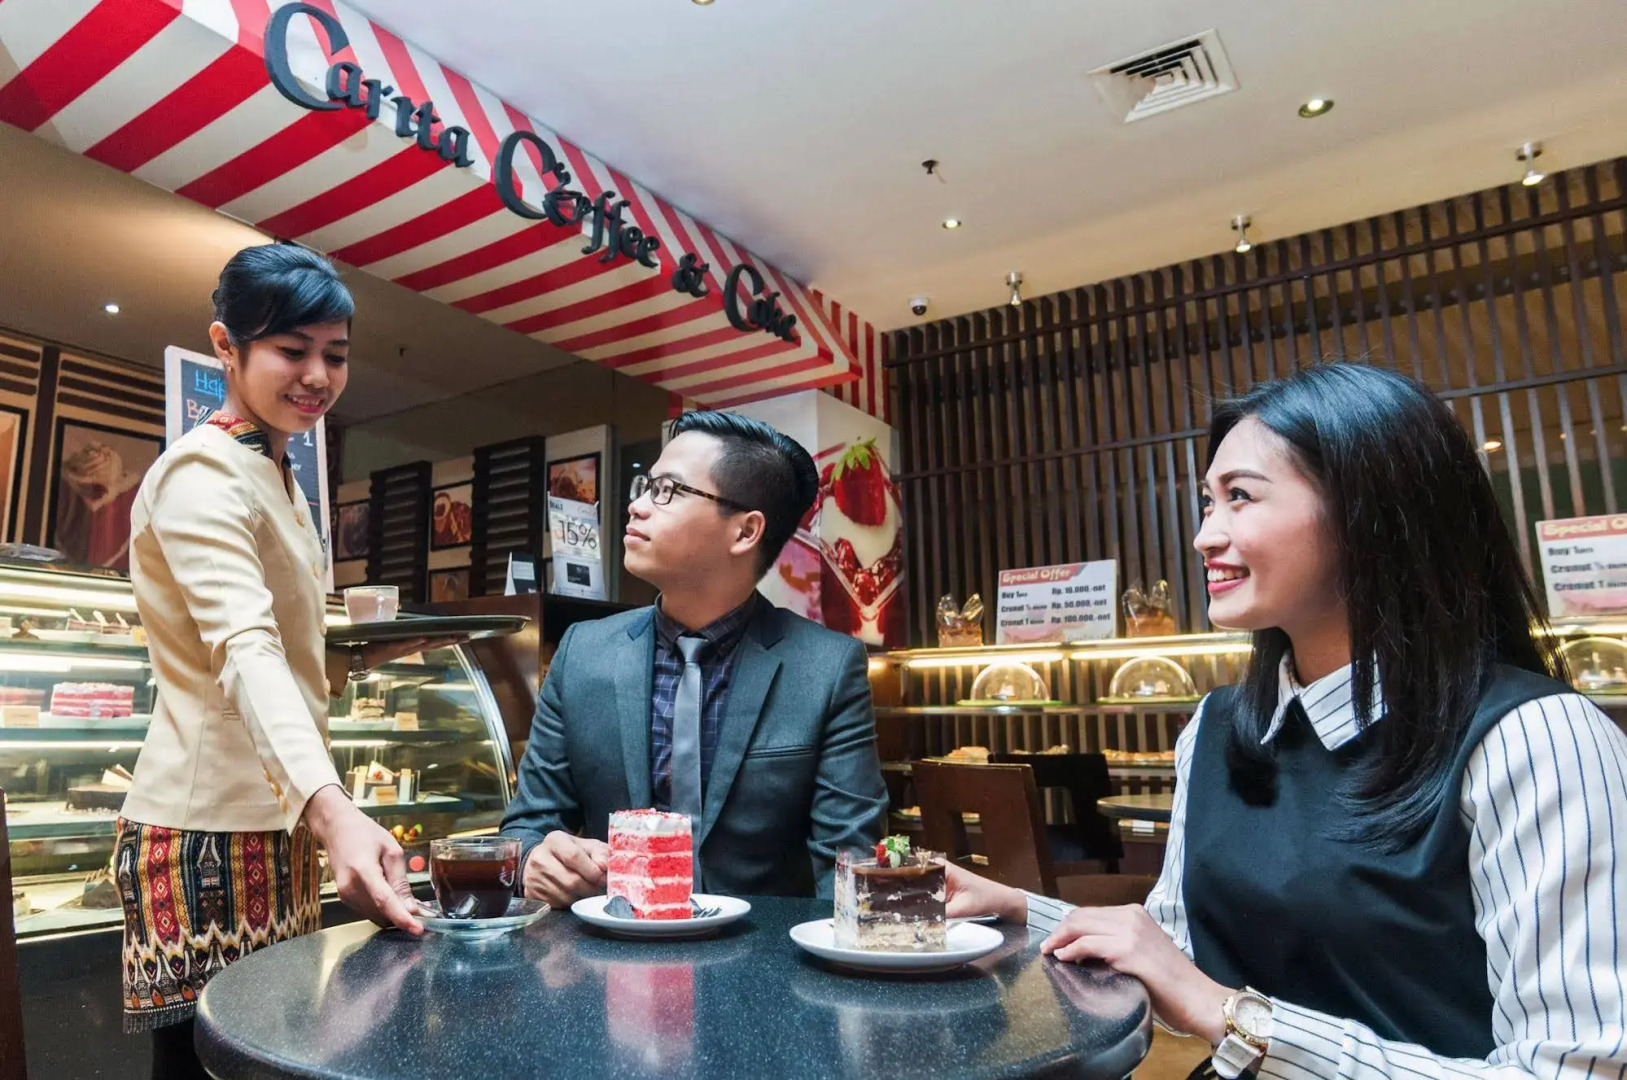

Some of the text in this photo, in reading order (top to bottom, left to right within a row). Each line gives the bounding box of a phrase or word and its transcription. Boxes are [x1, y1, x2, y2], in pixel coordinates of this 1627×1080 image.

[494, 130, 660, 268] Coffee
[671, 253, 710, 298] &
[724, 264, 797, 342] Cake
[559, 520, 597, 549] 15%
[1544, 519, 1607, 538] Special
[1548, 547, 1569, 556] Buy
[1002, 567, 1071, 585] Special Offer
